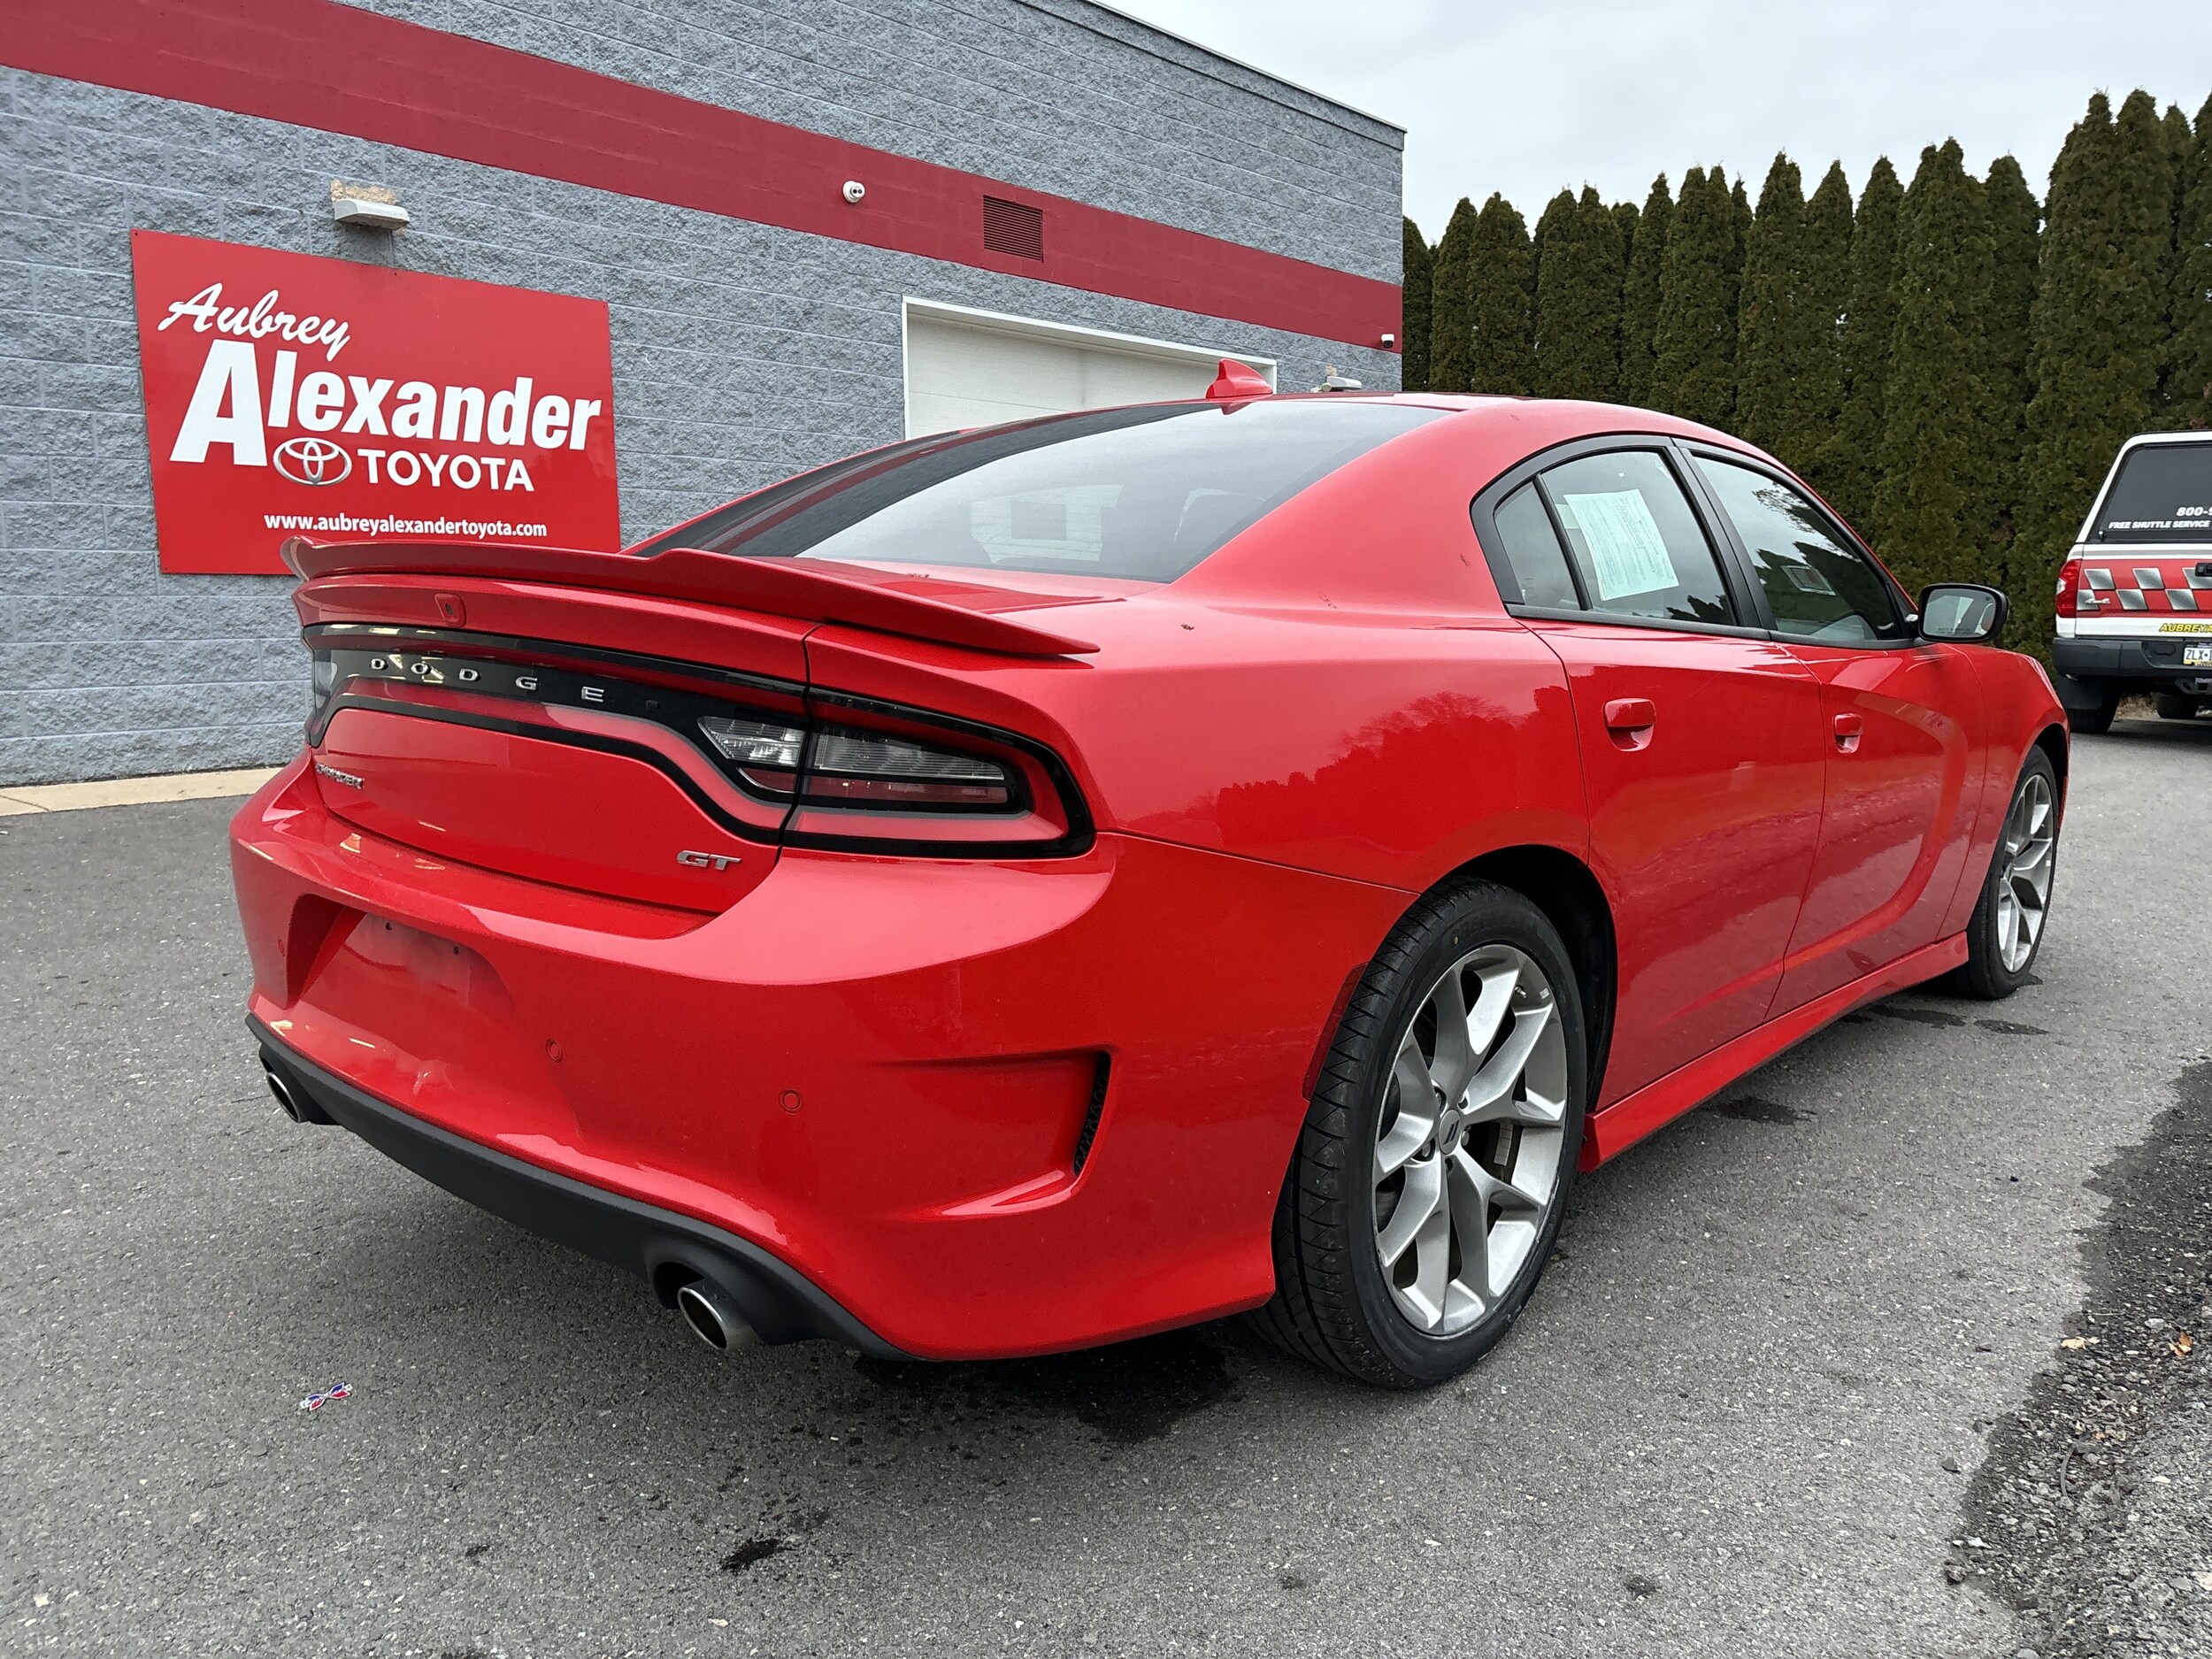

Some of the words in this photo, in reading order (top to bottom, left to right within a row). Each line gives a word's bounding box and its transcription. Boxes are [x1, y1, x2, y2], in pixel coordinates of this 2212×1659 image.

[157, 282, 351, 361] Aubrey
[169, 338, 603, 466] Alexander
[357, 448, 535, 492] TOYOTA
[264, 512, 548, 540] www.aubreyalexandertoyota.com
[2131, 520, 2171, 529] SHUTTLE
[370, 657, 605, 703] DODGE
[677, 849, 743, 871] GT
